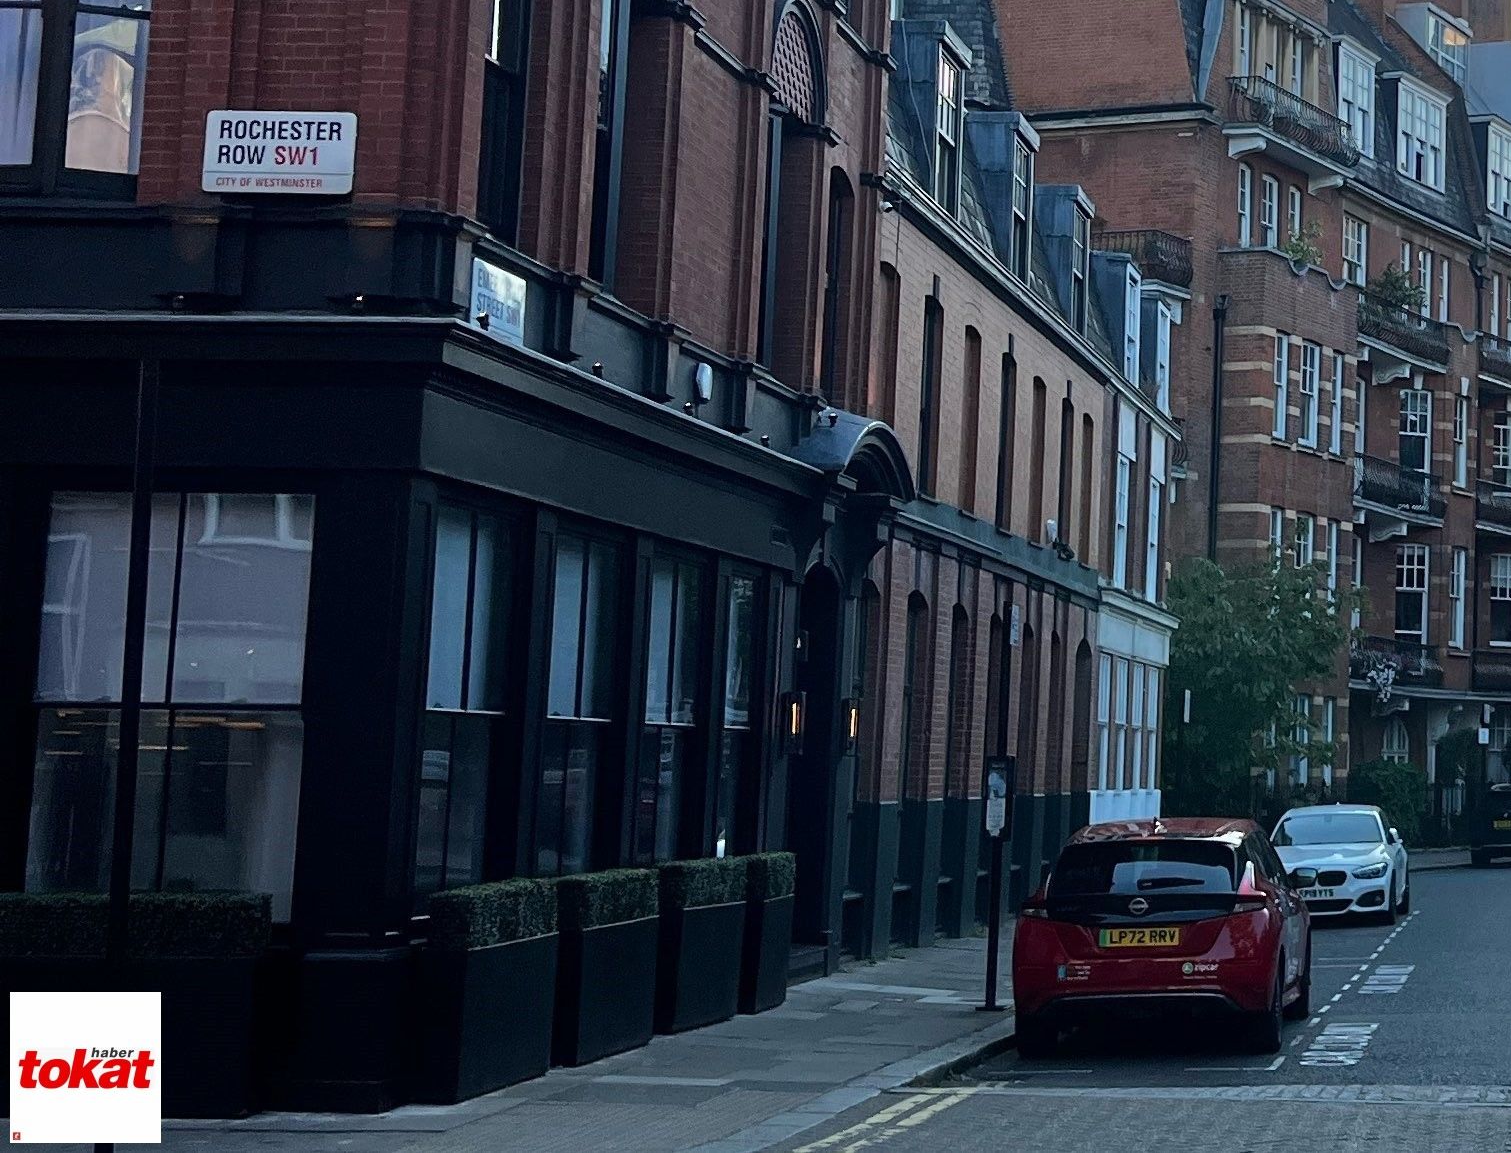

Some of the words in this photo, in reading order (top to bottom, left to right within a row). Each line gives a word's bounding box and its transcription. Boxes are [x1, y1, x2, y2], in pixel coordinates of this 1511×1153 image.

[219, 120, 342, 141] ROCHESTER
[217, 145, 266, 164] ROW
[274, 146, 319, 165] SW1
[216, 177, 237, 186] CITY
[240, 177, 251, 187] OF
[255, 178, 323, 188] WESTMINSTER
[1110, 930, 1146, 944] LP72
[1149, 929, 1176, 943] RRV
